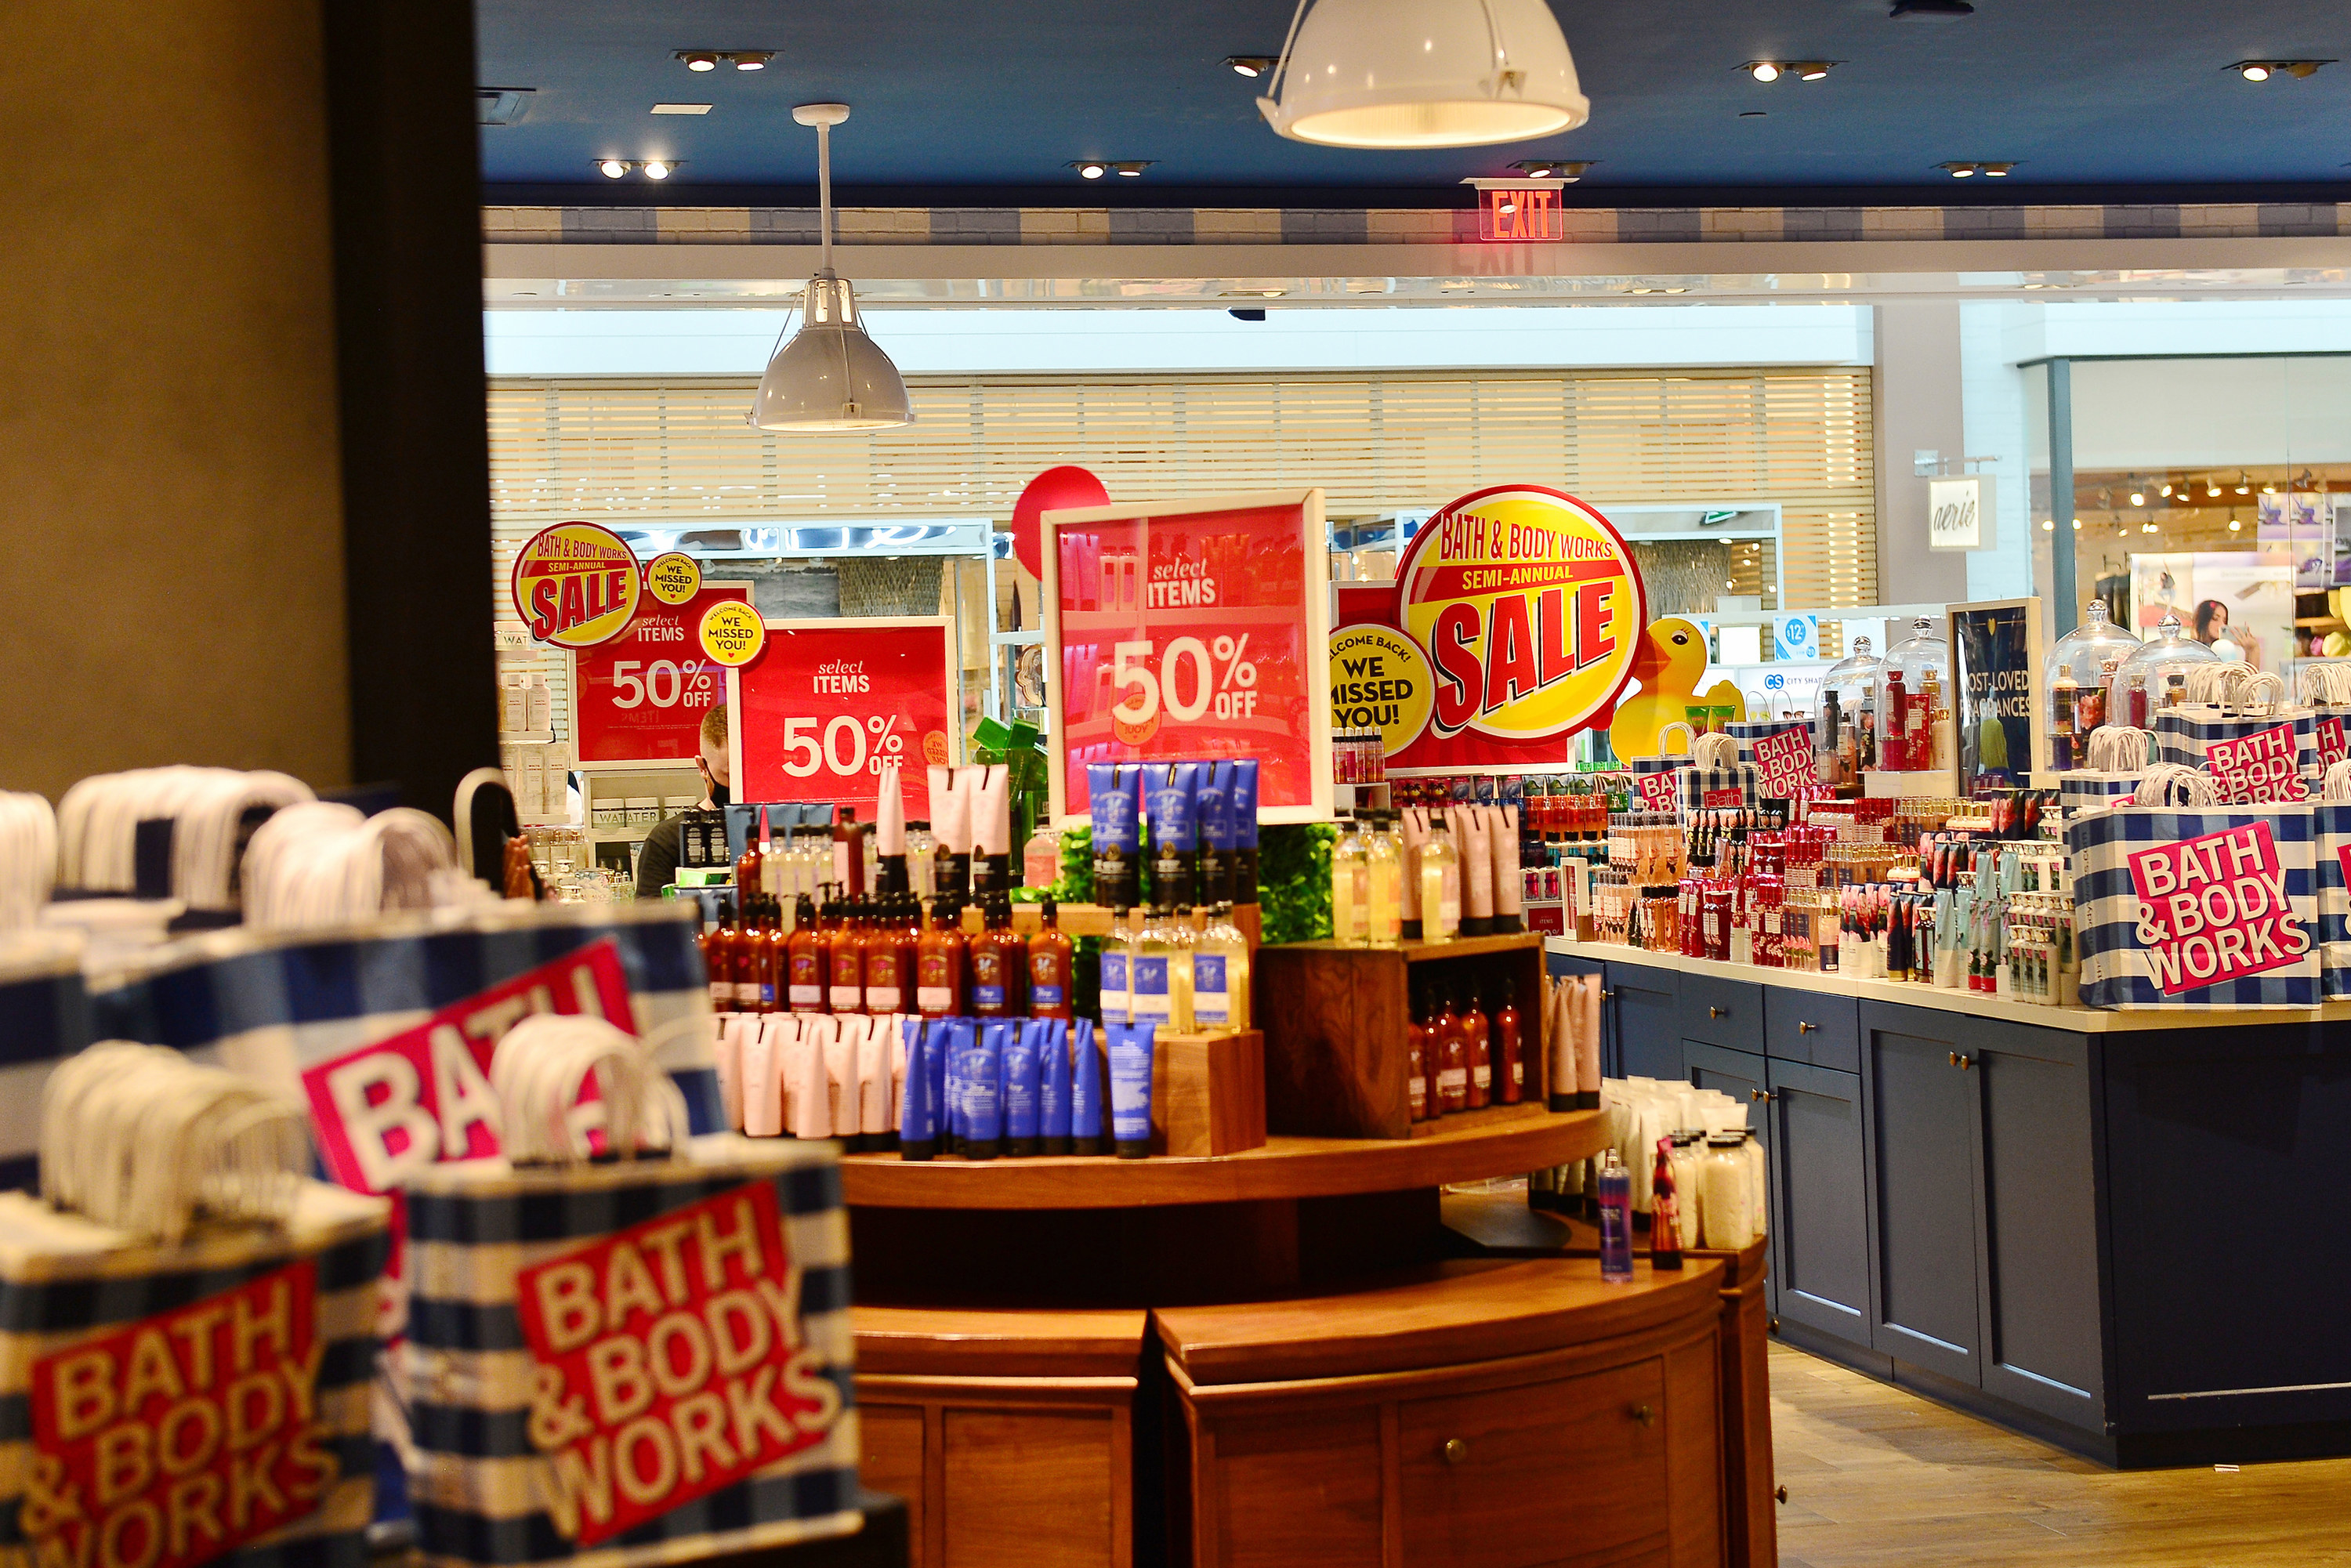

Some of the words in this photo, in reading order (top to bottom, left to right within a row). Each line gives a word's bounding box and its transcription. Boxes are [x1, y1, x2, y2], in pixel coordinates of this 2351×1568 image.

[1492, 190, 1552, 238] EXIT
[1933, 490, 1976, 531] aerie
[537, 534, 560, 558] BATH
[563, 538, 571, 558] &
[572, 539, 599, 559] BODY
[599, 545, 627, 559] WORKS
[1440, 512, 1487, 561] BATH
[1491, 519, 1504, 560] &
[1509, 523, 1556, 560] BODY
[1559, 533, 1613, 559] WORKS
[548, 561, 606, 573] SEMI-ANNUAL
[656, 557, 680, 569] WELCOME
[666, 565, 683, 574] WE
[1153, 557, 1208, 578] select
[654, 574, 693, 585] MISSED
[660, 583, 686, 593] YOU!
[1462, 565, 1574, 591] SEMI-ANNUAL
[532, 570, 628, 642] SALE
[1147, 578, 1216, 608] ITEMS
[642, 614, 679, 626] select
[708, 607, 737, 621] WELCOME
[721, 616, 741, 627] WE
[504, 636, 527, 645] WAT
[638, 627, 685, 642] ITEMS
[708, 628, 754, 639] MISSED
[715, 640, 747, 650] YOU!
[1329, 635, 1374, 662] LCOME
[1375, 636, 1411, 663] BACK!
[1431, 581, 1617, 733] SALE
[818, 659, 864, 674] select
[1111, 632, 1257, 726] 50%
[1341, 656, 1385, 679] WE
[611, 659, 712, 709] 50%
[813, 675, 871, 694] ITEMS
[1765, 674, 1784, 690] CS
[1967, 670, 2029, 692] OST-LOVED
[683, 692, 712, 708] OFF
[1215, 690, 1257, 722] OFF
[1333, 704, 1400, 729] YOU!
[781, 714, 904, 778] 50%
[1756, 728, 1805, 762] BATH
[2212, 728, 2288, 773] BATH
[869, 755, 904, 776] OFF
[1758, 764, 1770, 784] &
[1769, 744, 1814, 779] BODY
[2212, 775, 2228, 798] &
[2229, 749, 2300, 794] BODY
[1706, 792, 1741, 808] Bath
[2217, 774, 2311, 804] ORKS
[600, 813, 625, 823] WAT
[627, 812, 657, 823] ATER
[2139, 828, 2265, 897] BATH
[2135, 903, 2171, 945] &
[2168, 867, 2288, 937] BODY
[2143, 912, 2311, 990] WORKS
[534, 1197, 765, 1354] BATH
[52, 1277, 292, 1441] BATH
[527, 1362, 596, 1450] &
[585, 1263, 804, 1426] BODY
[17, 1454, 87, 1534] &
[93, 1336, 326, 1504] BODY
[537, 1346, 843, 1541] WORKS
[30, 1420, 342, 1568] WORKS
